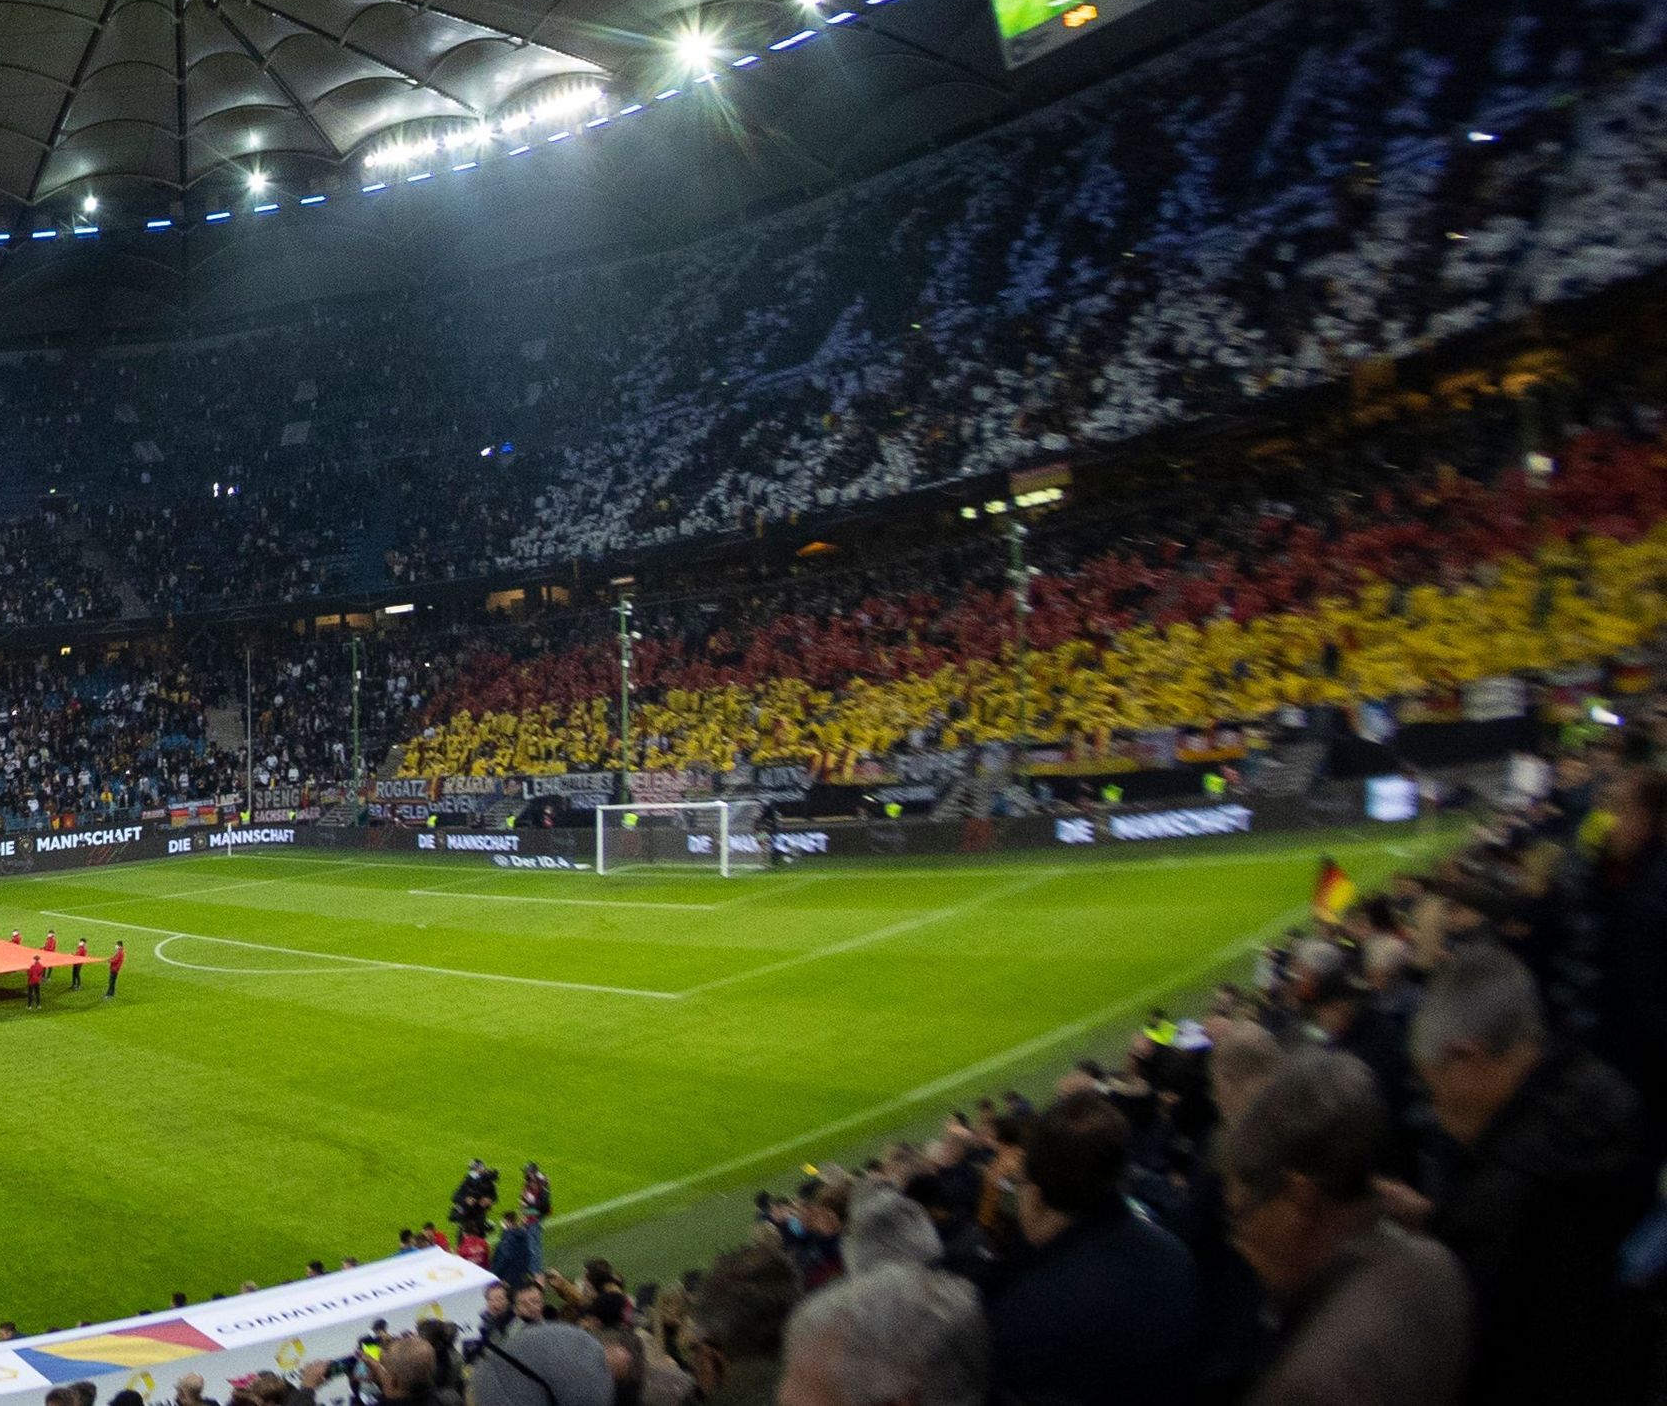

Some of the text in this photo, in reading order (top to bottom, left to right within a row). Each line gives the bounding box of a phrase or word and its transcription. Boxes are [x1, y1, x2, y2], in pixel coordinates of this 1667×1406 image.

[36, 825, 143, 852] MANNSCHAFT
[168, 829, 295, 854] DIE MANNSCHAFT
[217, 1278, 424, 1335] COMMERZBANK
